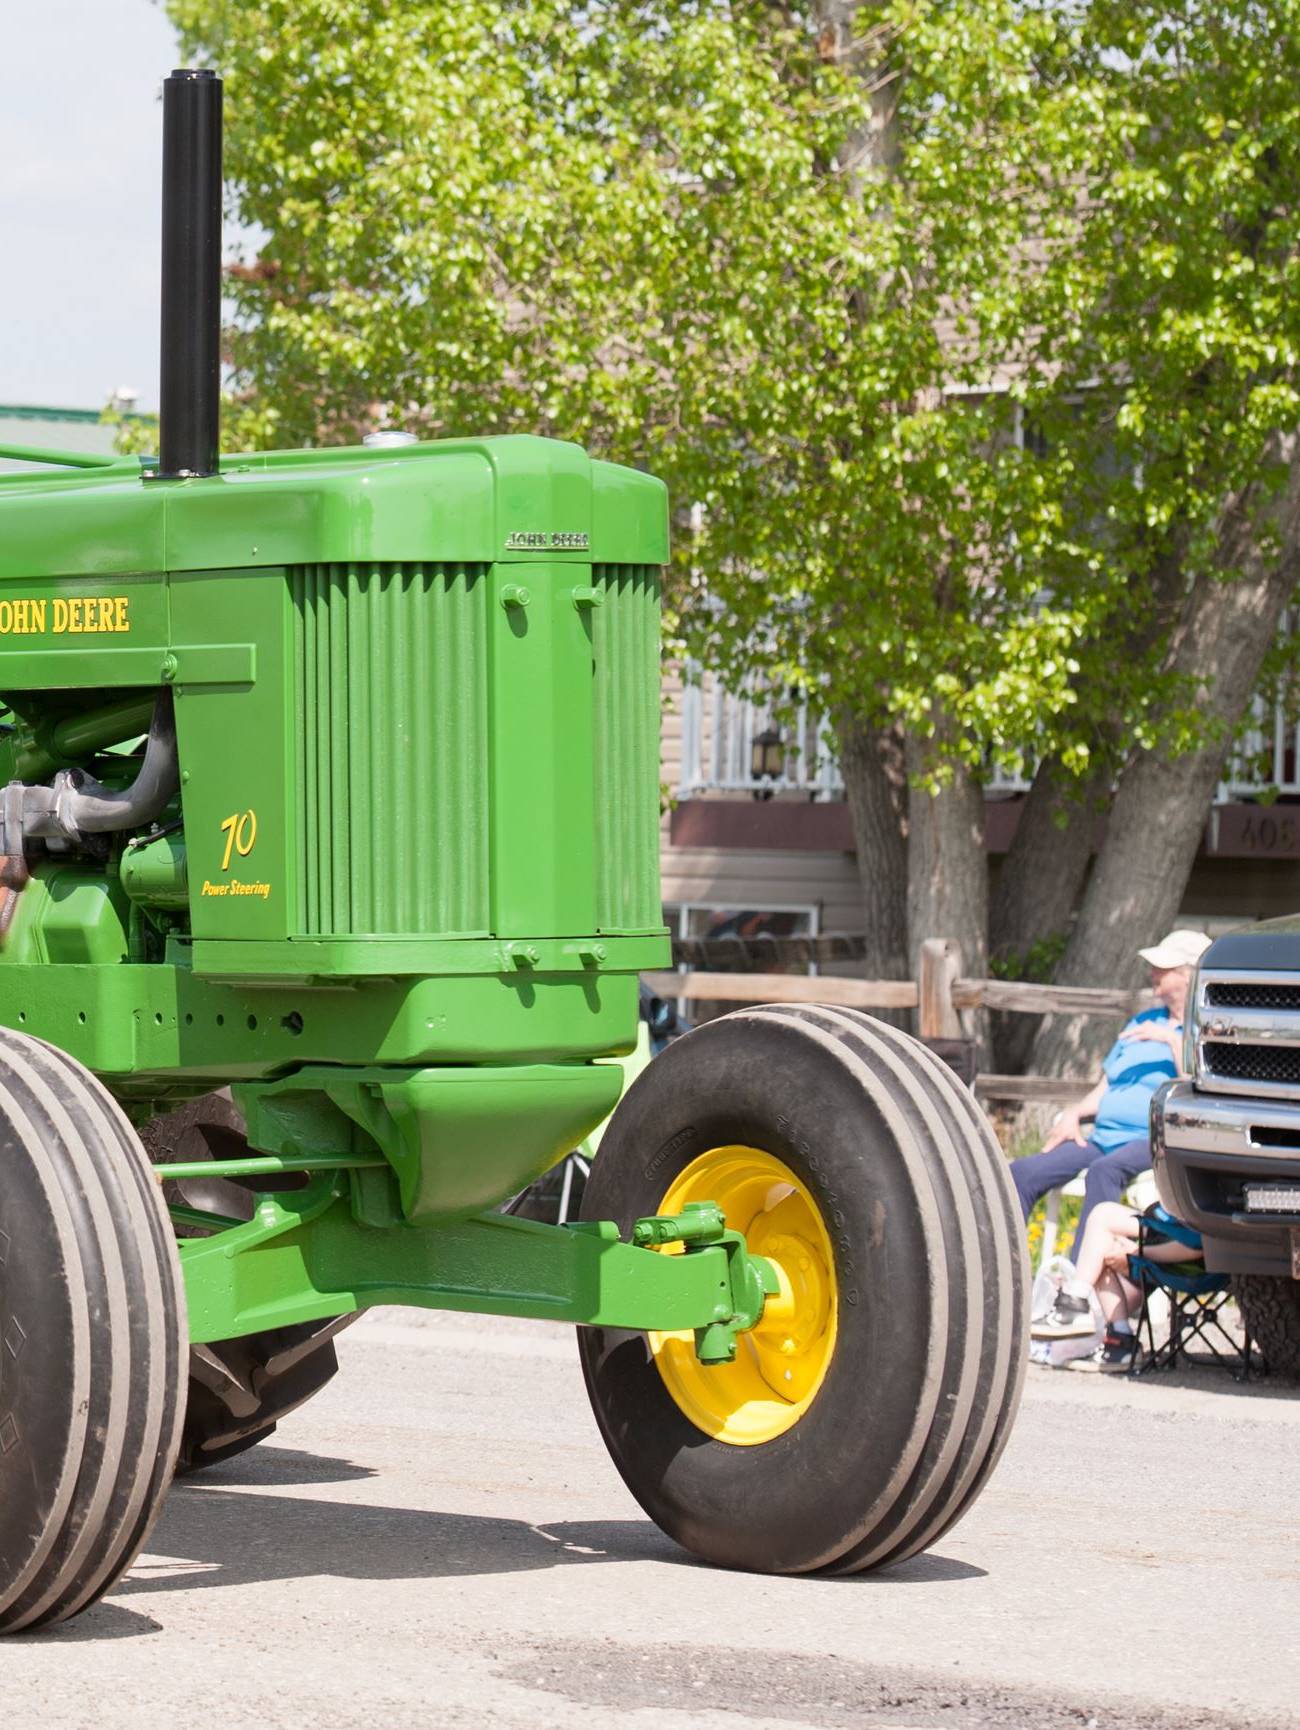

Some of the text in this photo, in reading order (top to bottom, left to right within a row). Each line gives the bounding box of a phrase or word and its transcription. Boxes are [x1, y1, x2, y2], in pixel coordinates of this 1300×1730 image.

[52, 597, 130, 633] DEERE
[221, 809, 257, 872] 70
[201, 880, 271, 900] Power Steering
